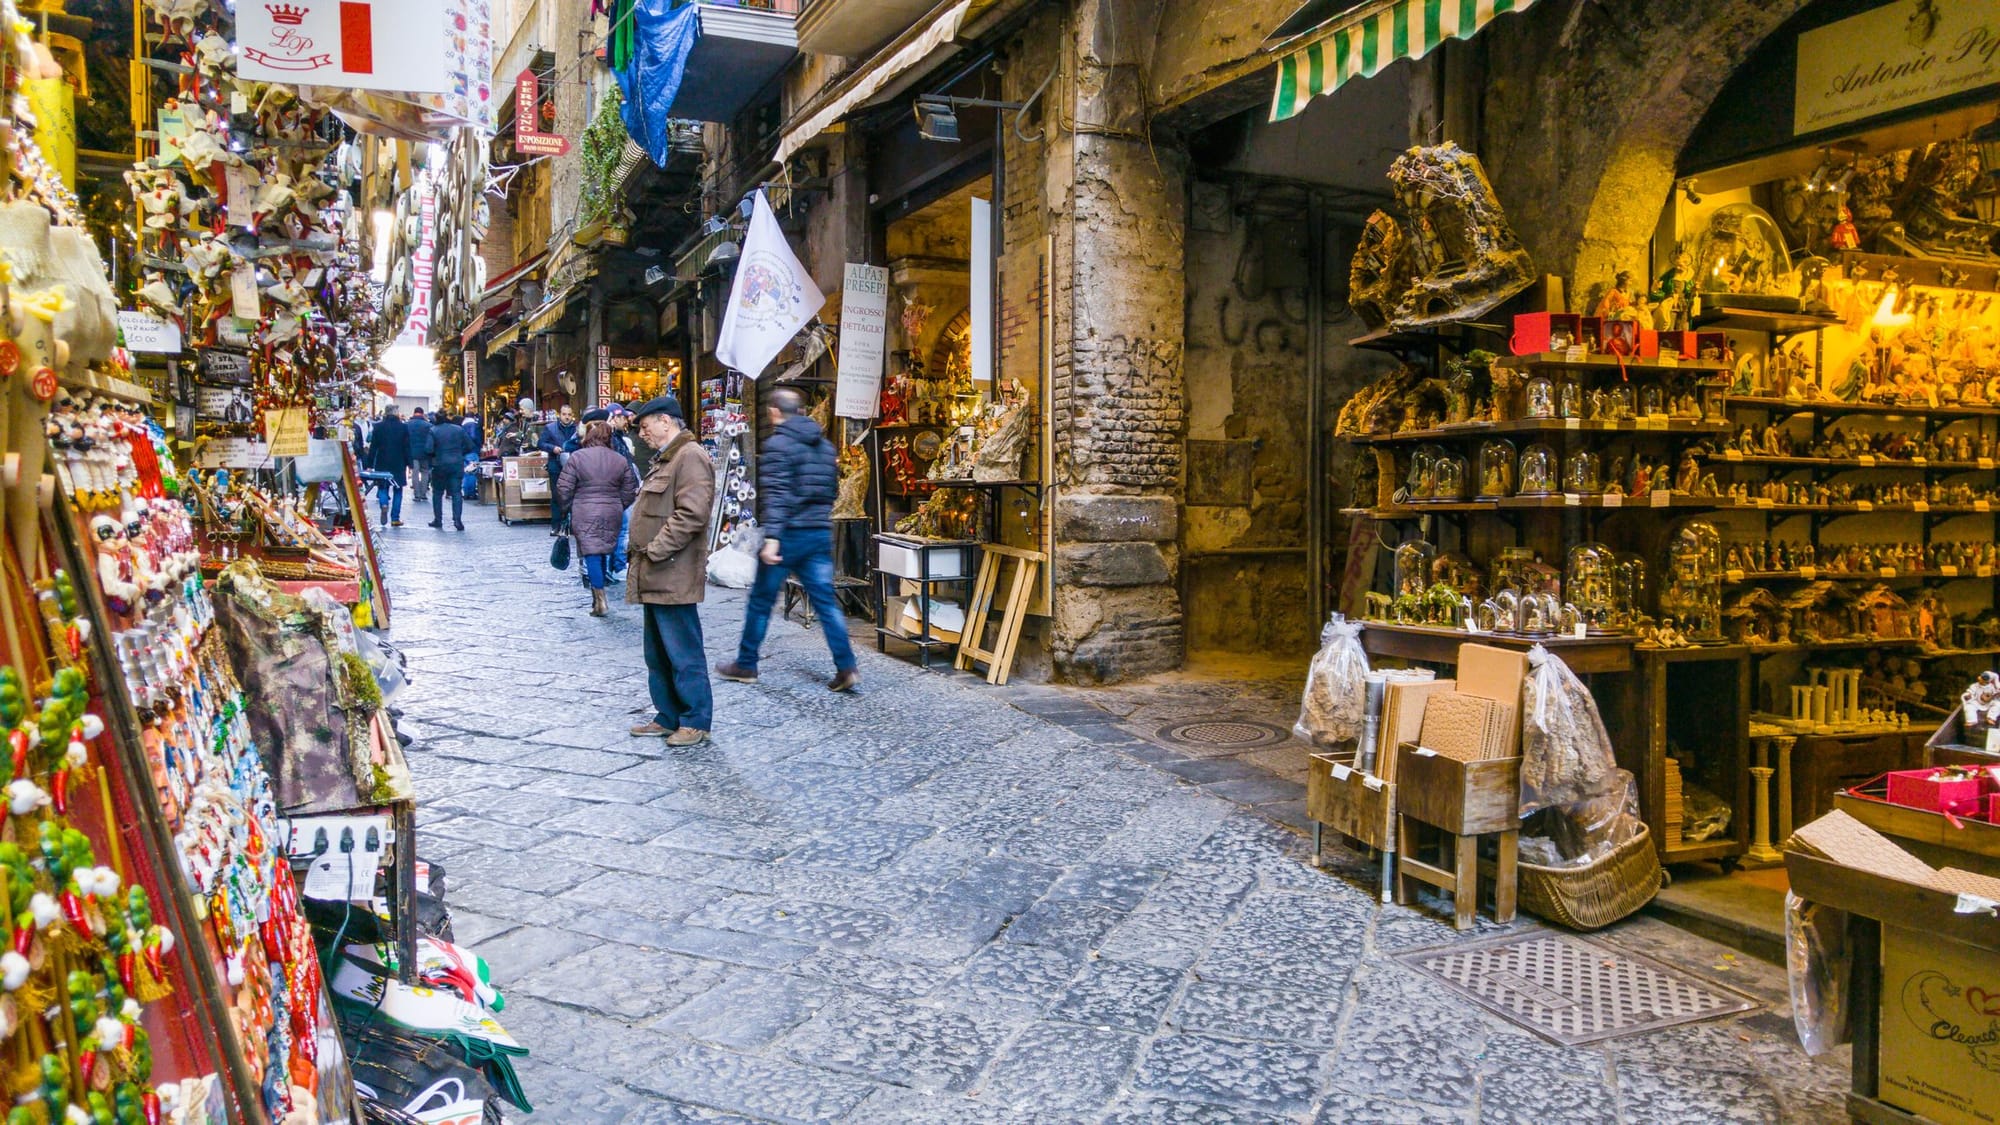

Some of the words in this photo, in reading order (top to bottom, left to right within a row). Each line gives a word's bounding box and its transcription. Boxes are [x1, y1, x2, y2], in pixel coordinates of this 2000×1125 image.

[1825, 50, 1937, 99] Antonio
[520, 80, 533, 132] FERRIGNO
[519, 135, 564, 147] ESPOSIZIONE
[850, 265, 883, 281] ALPA3
[845, 278, 886, 295] PRESEPI
[844, 304, 885, 317] INGROSSO
[843, 321, 883, 334] DETTAGLIO
[1500, 976, 1556, 1002] ENEL
